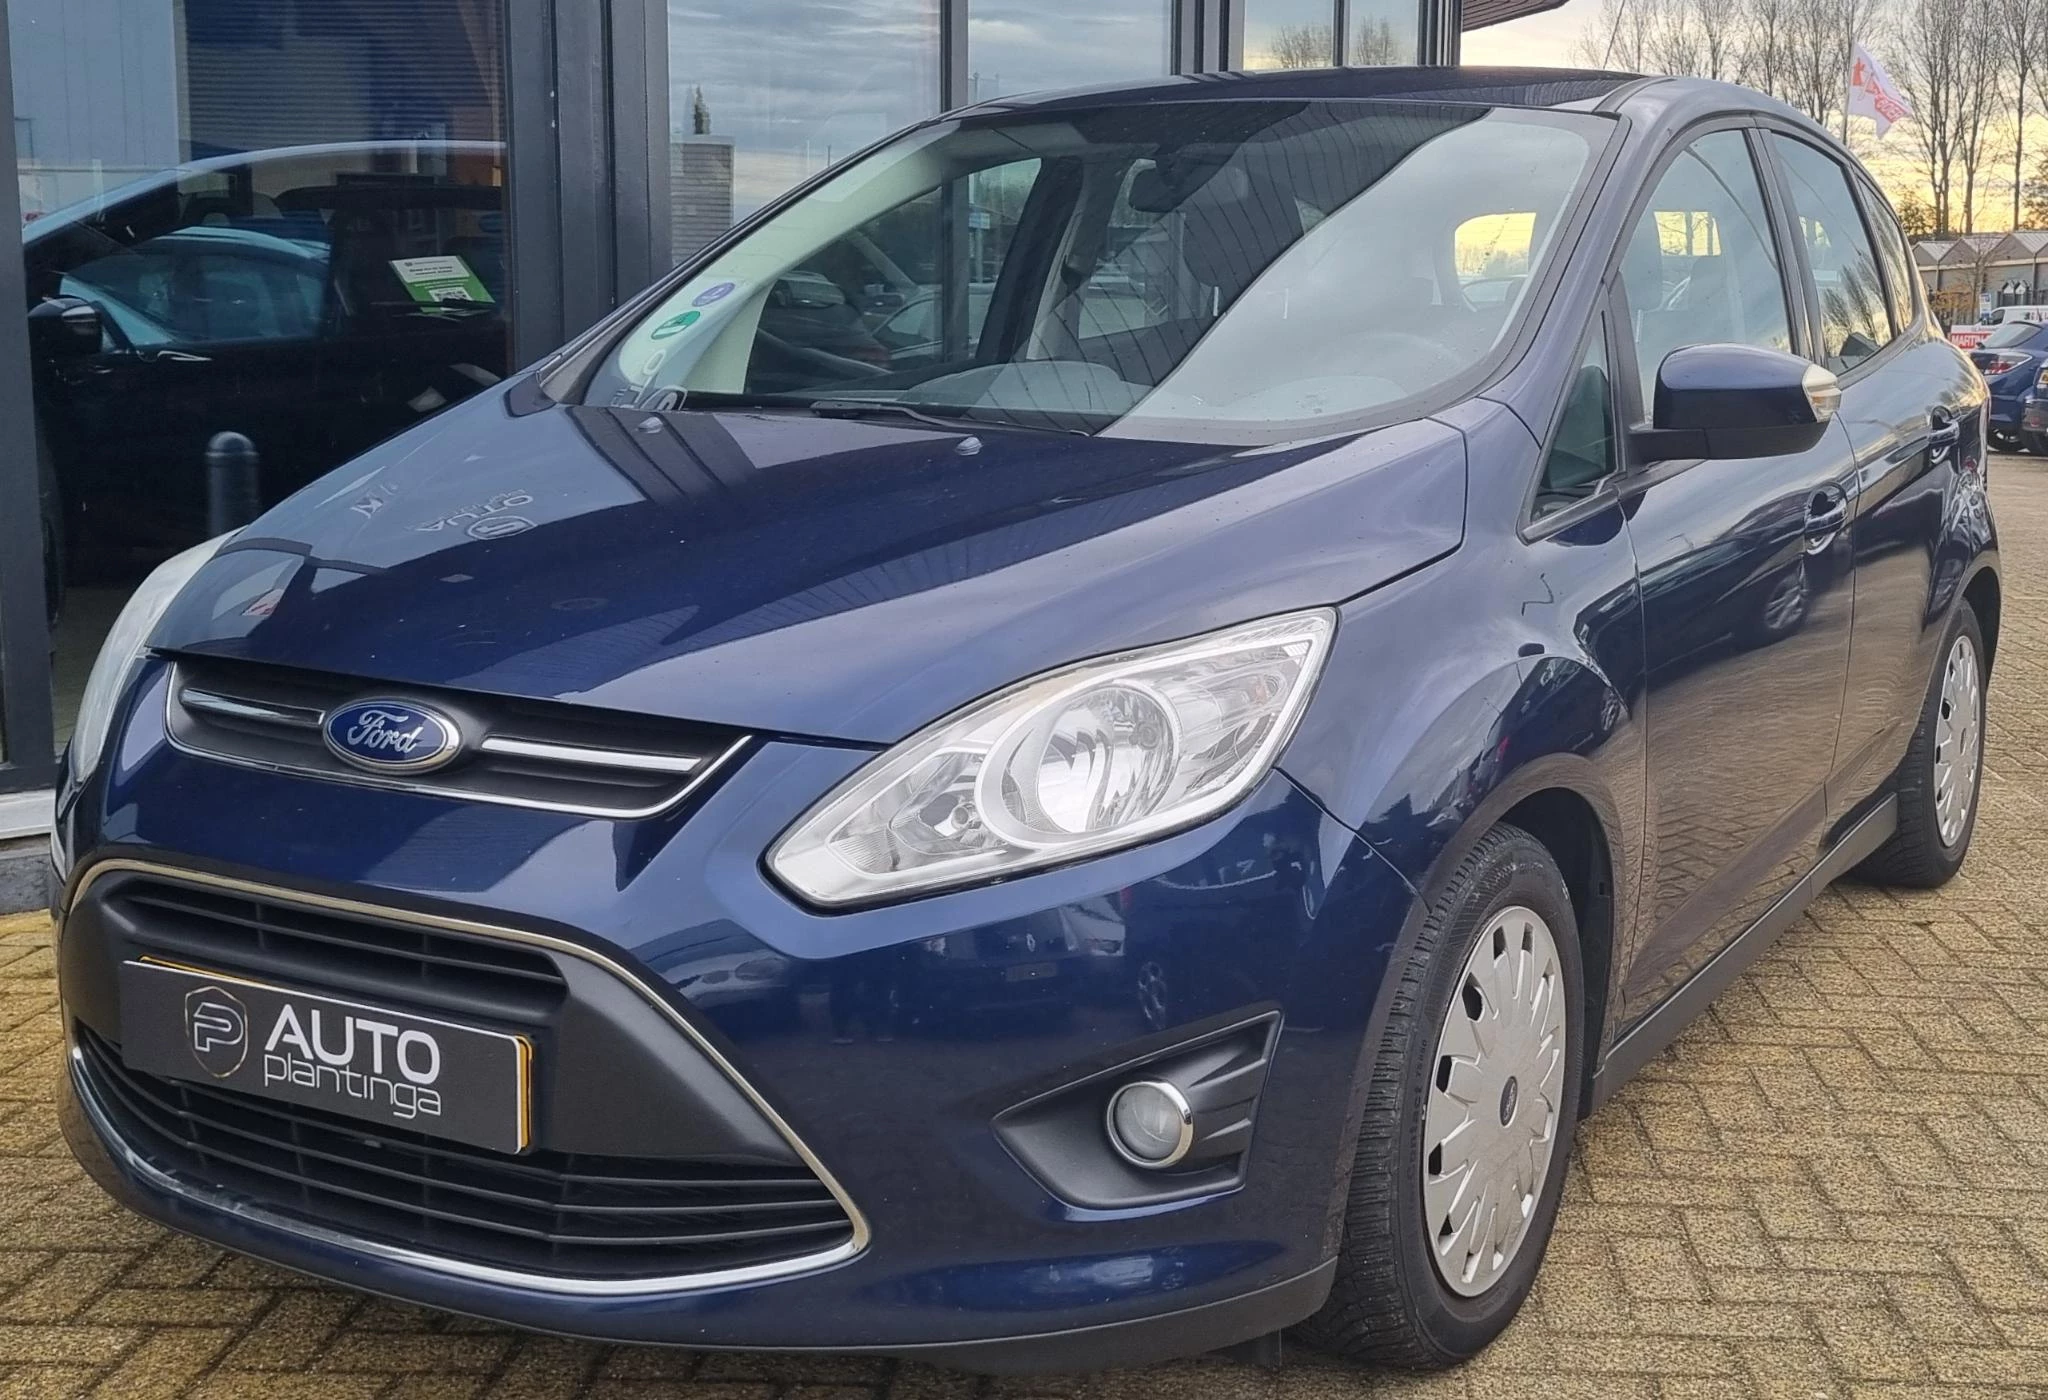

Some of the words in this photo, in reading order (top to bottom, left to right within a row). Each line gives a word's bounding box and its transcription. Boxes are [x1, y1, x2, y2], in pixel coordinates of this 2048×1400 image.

[347, 709, 424, 753] Ford
[264, 1004, 440, 1084] AUTO
[264, 1054, 441, 1119] plantinga
